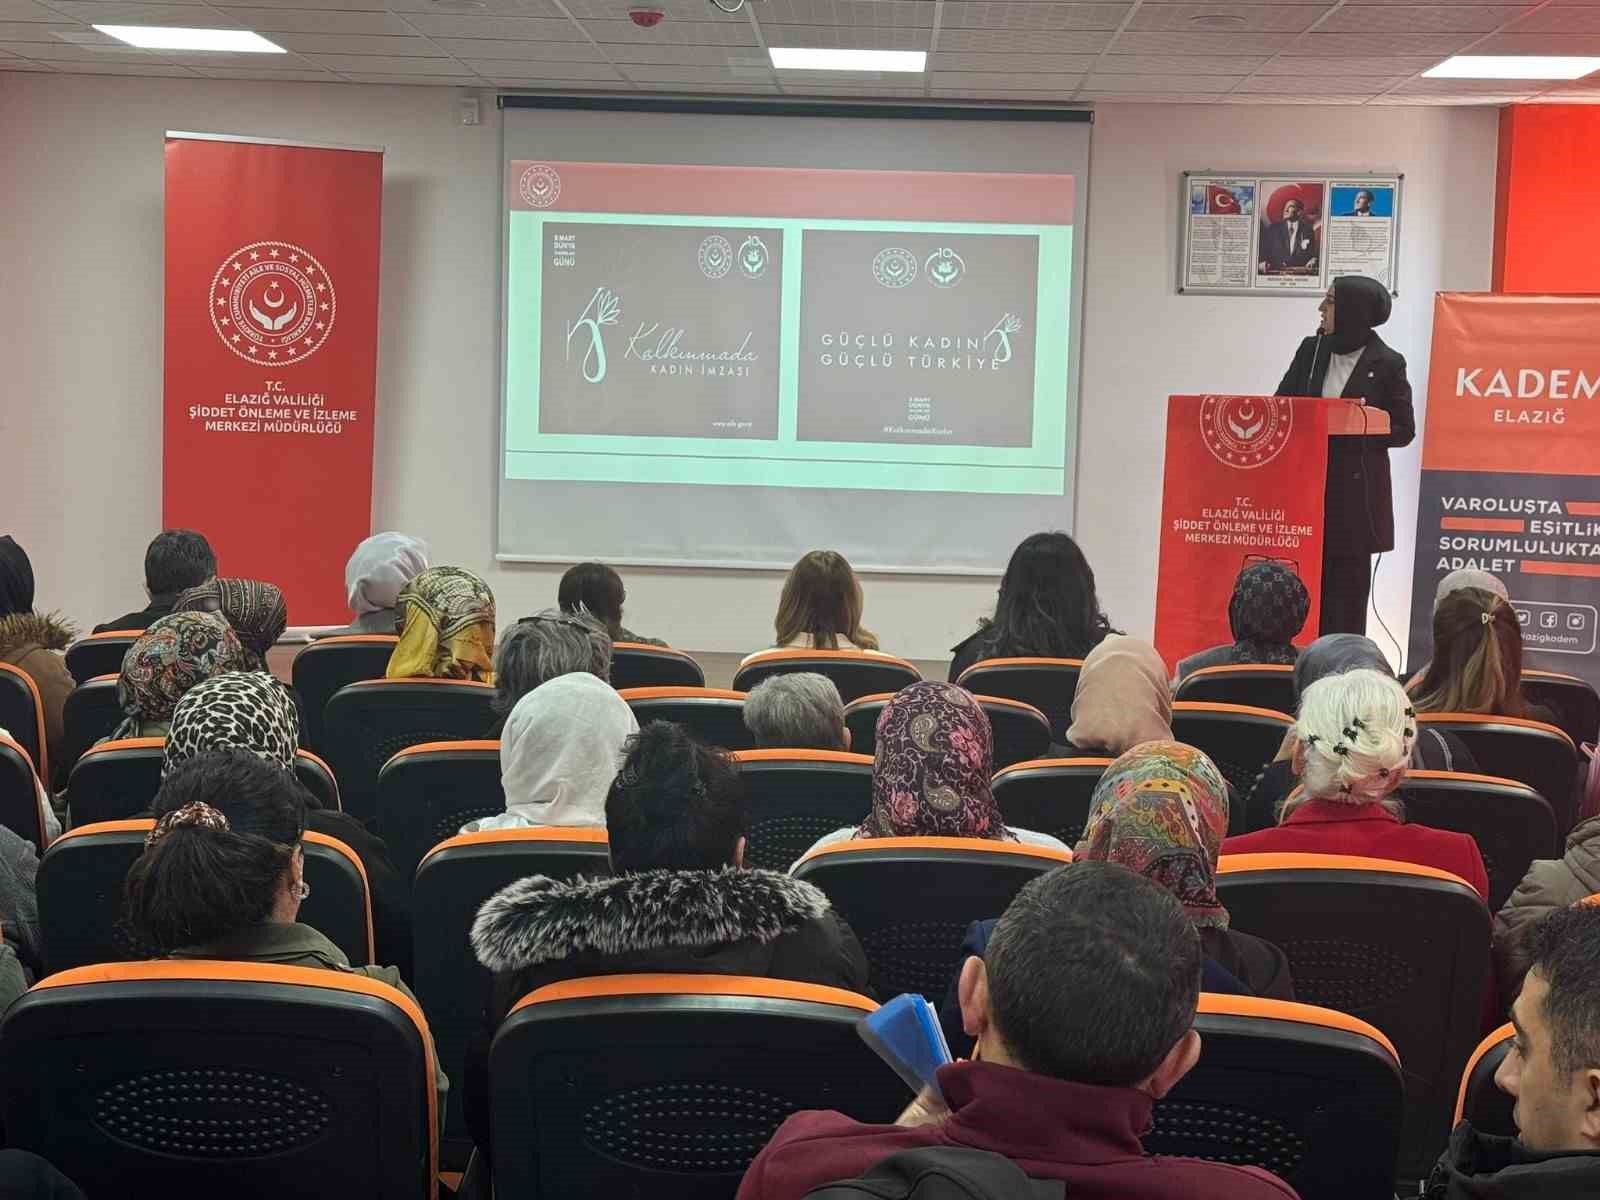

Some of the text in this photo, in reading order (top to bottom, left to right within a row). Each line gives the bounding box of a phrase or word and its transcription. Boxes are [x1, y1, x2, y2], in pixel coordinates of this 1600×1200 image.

[821, 331, 979, 350] GÜÇLÜ KADIN
[820, 352, 1000, 370] GÜÇLÜ TÜRKİYE
[650, 364, 693, 376] KADIN
[265, 380, 286, 391] T.C.
[224, 392, 324, 406] ELAZIĞ VALİLİĞİ
[189, 404, 357, 421] ŞİDDET ÖNLEME VE İZLEME
[1493, 407, 1566, 424] ELAZIĞ
[205, 420, 342, 434] MERKEZİ MÜDÜRLÜĞÜ
[1235, 497, 1252, 507] T.C.
[1441, 496, 1562, 515] VAROLUŞTA
[1202, 507, 1285, 521] ELAZIĞ VALİLİĞİ
[1173, 518, 1313, 536] ŞİDDET ÖNLEME VE İZLEME
[1185, 533, 1300, 548] MERKEZİ MÜDÜRLÜĞÜ
[1439, 537, 1600, 557] SORUMLULUKTA
[1436, 557, 1516, 573] ADALET
[1520, 632, 1579, 644] lazigkadem
